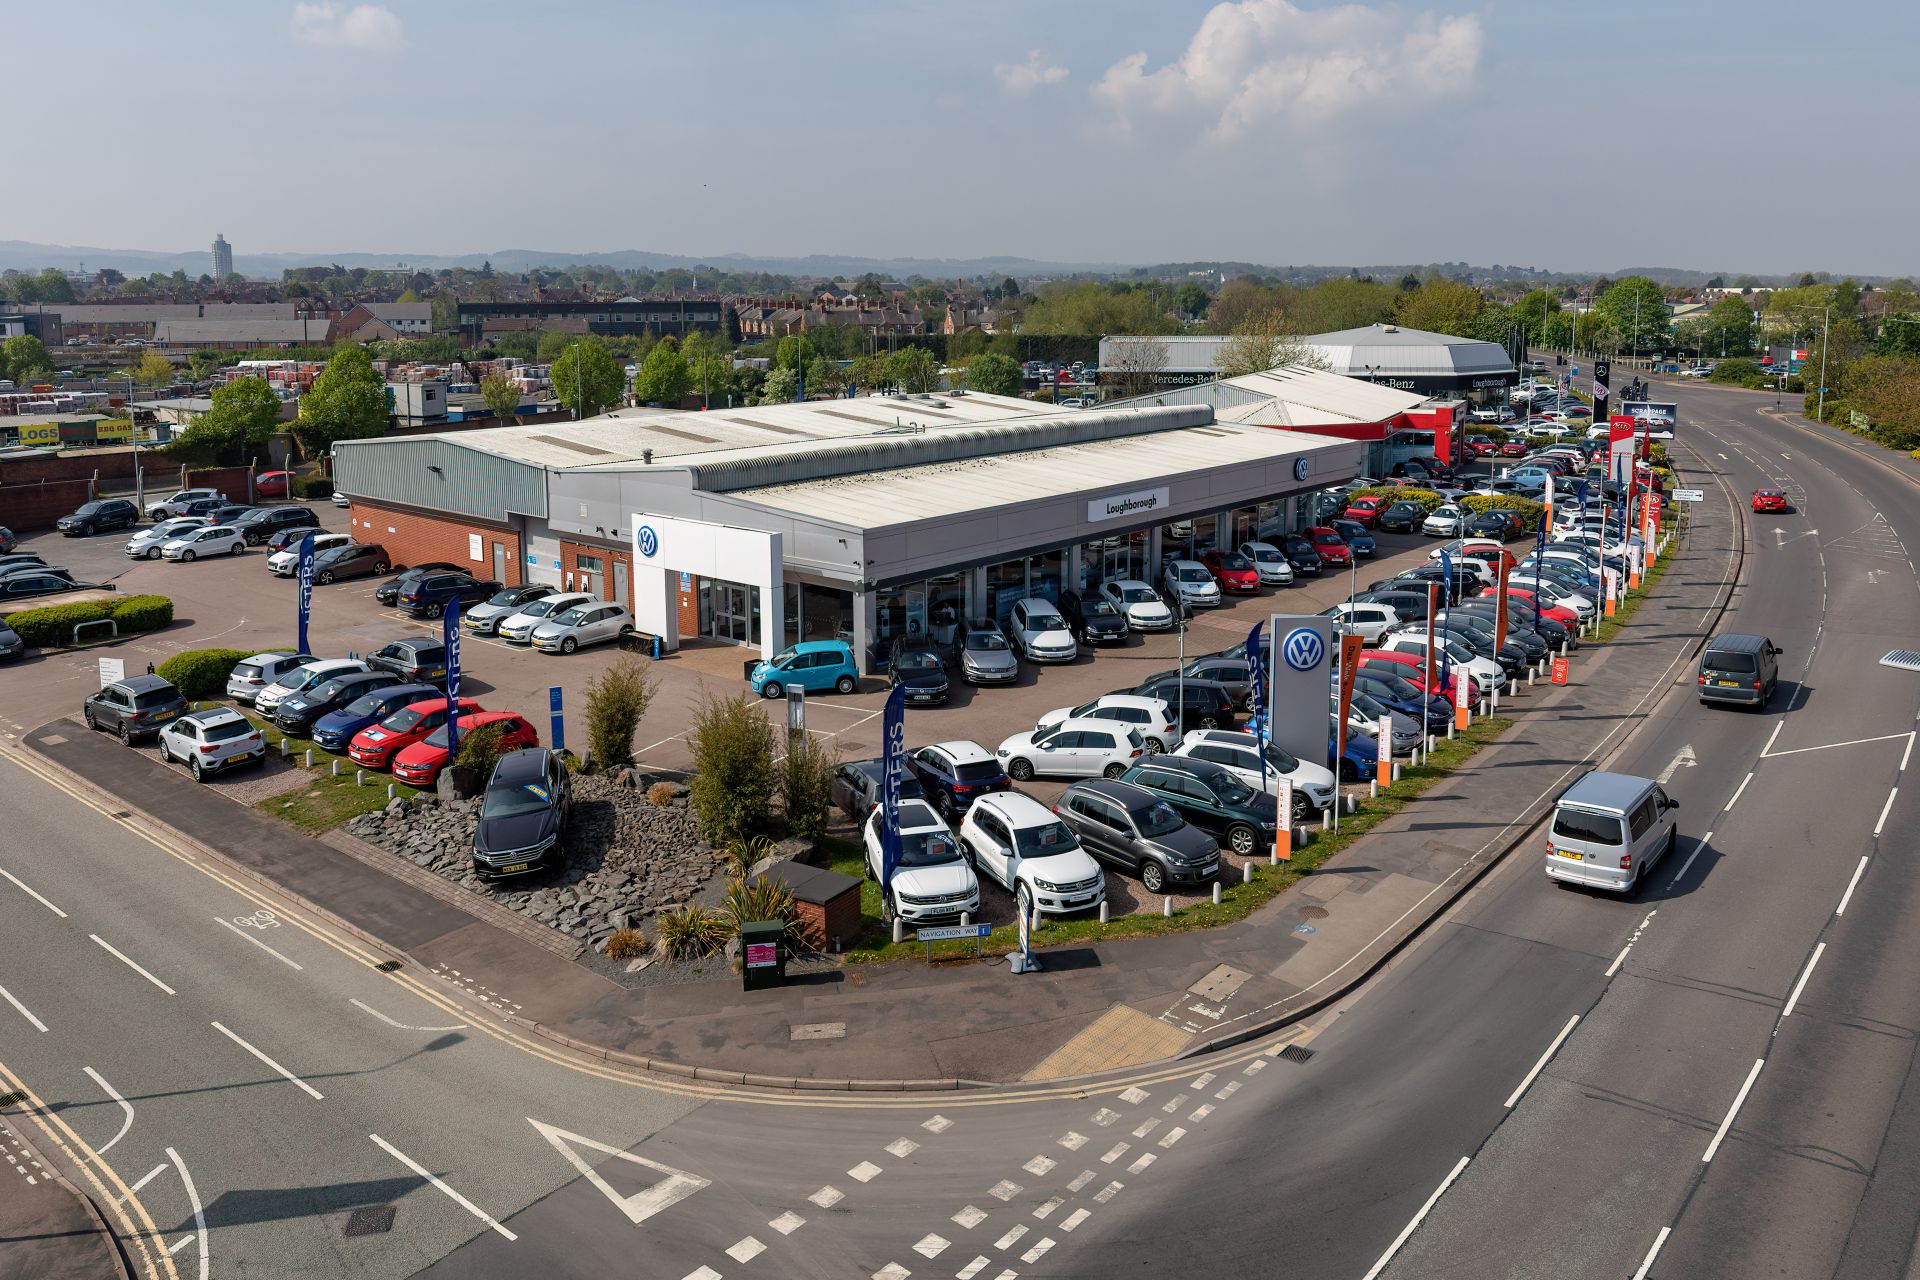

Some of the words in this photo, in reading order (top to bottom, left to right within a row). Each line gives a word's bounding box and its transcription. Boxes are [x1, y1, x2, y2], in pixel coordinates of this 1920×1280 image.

[1472, 378, 1507, 388] Loughborough
[19, 428, 59, 441] LOGS
[1106, 494, 1157, 514] Loughborough
[639, 527, 656, 556] VW
[1287, 631, 1323, 669] VW
[920, 929, 961, 938] NAVIGATION
[964, 927, 977, 935] WAY
